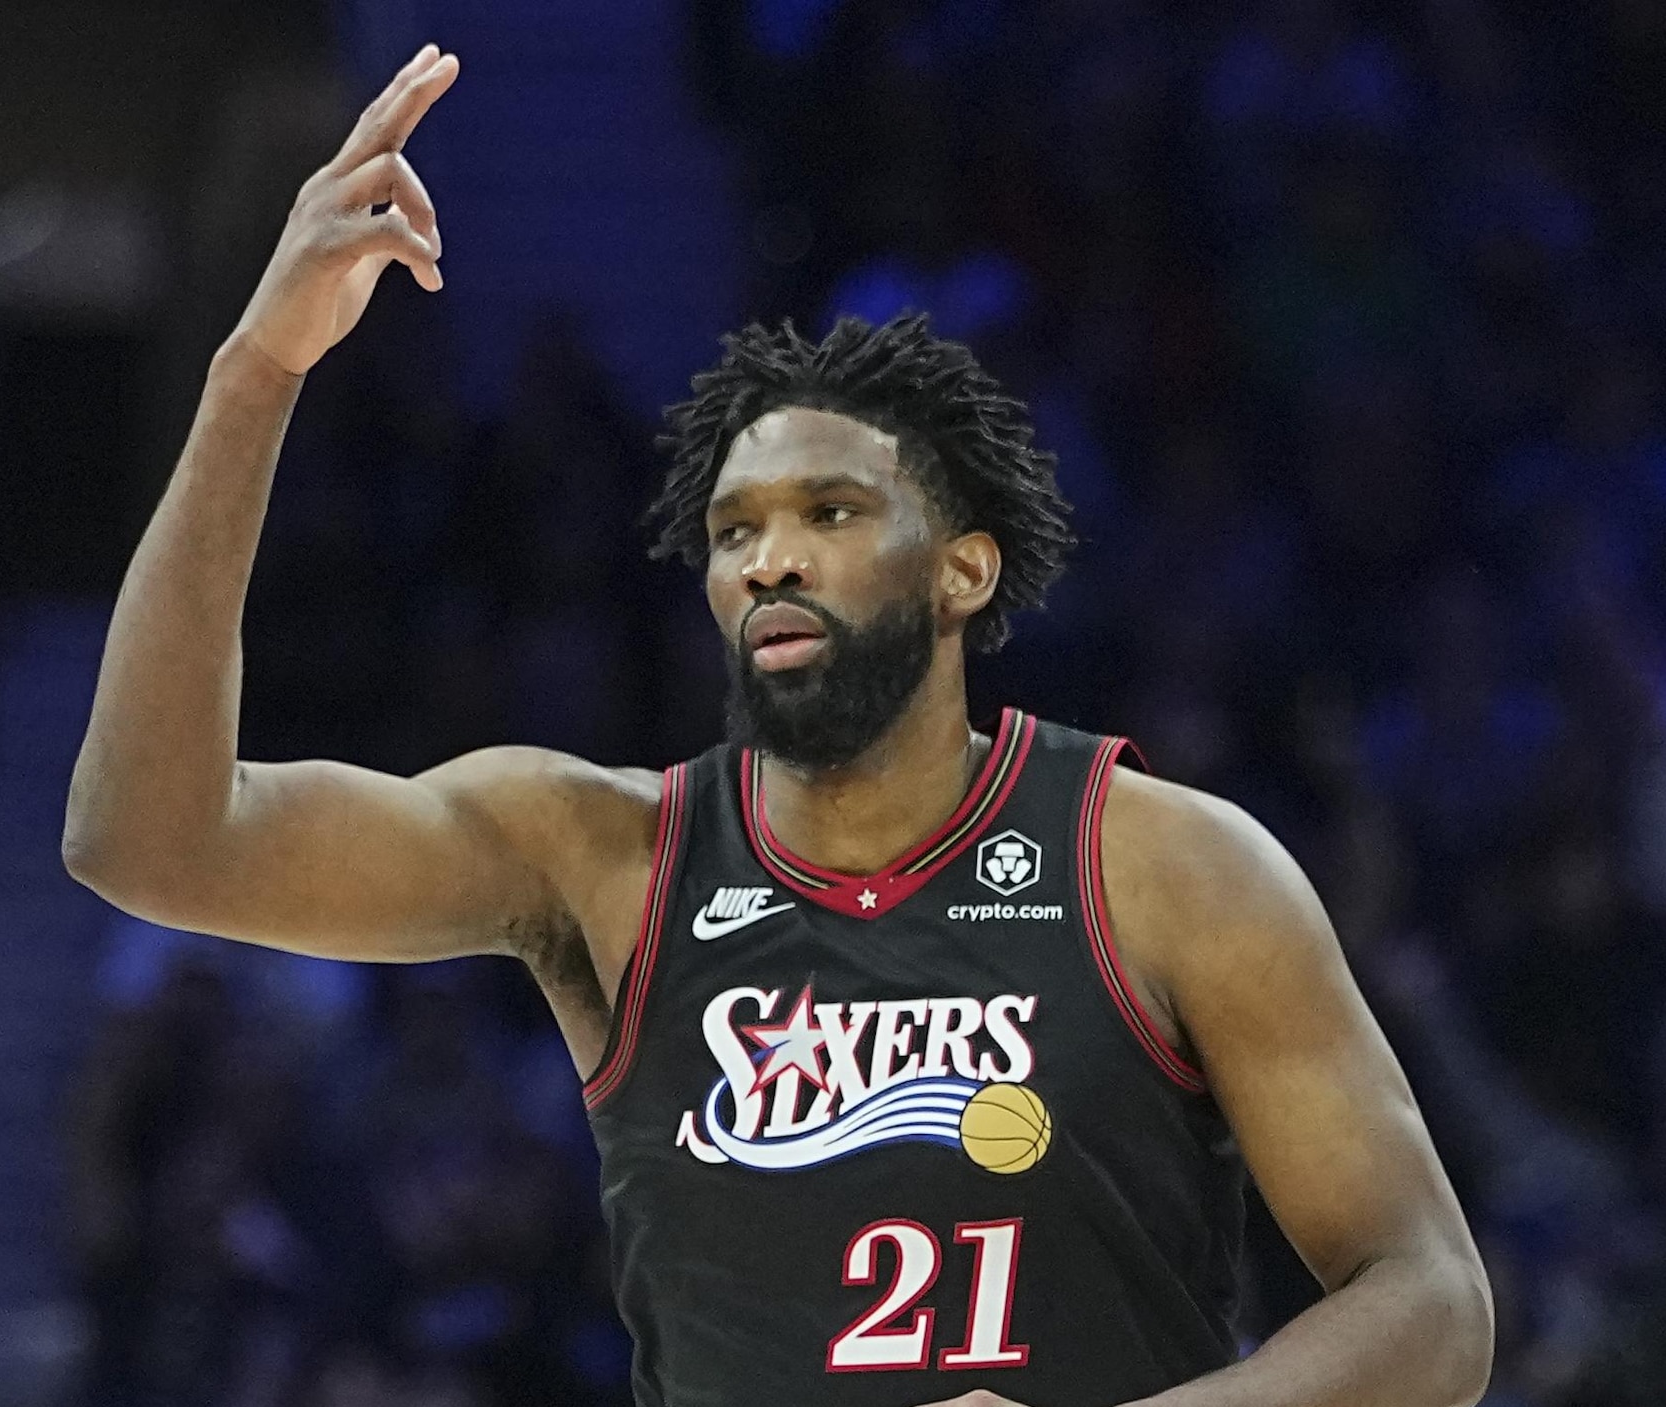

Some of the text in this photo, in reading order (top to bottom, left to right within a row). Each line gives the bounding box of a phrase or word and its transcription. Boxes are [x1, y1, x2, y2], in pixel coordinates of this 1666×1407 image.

[706, 886, 774, 919] NIKE
[946, 902, 1063, 922] crypto.com
[676, 984, 1038, 1164] SIXERS
[826, 1217, 1030, 1372] 21
